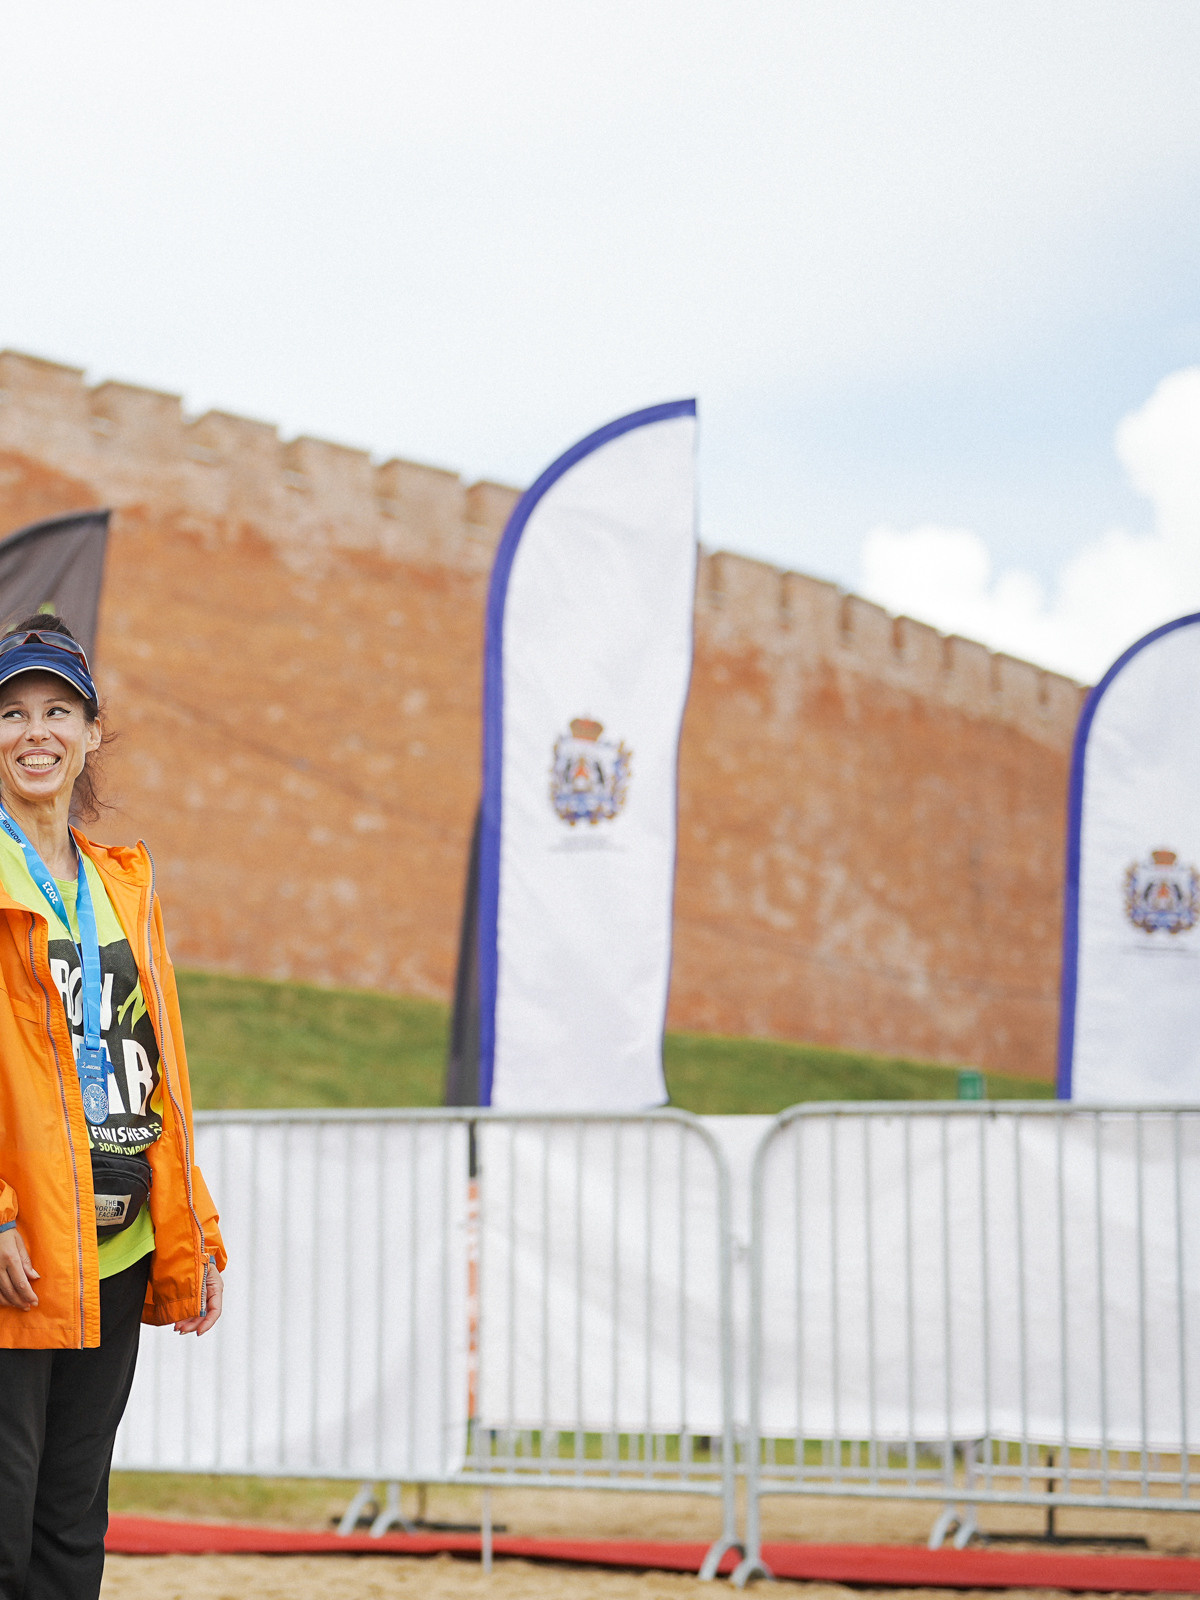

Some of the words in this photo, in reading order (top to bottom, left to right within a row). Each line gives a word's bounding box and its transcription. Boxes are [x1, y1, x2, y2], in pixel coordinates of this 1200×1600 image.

[42, 881, 58, 905] 2023
[90, 1126, 154, 1143] FINISHER
[98, 1142, 123, 1155] SOCHI
